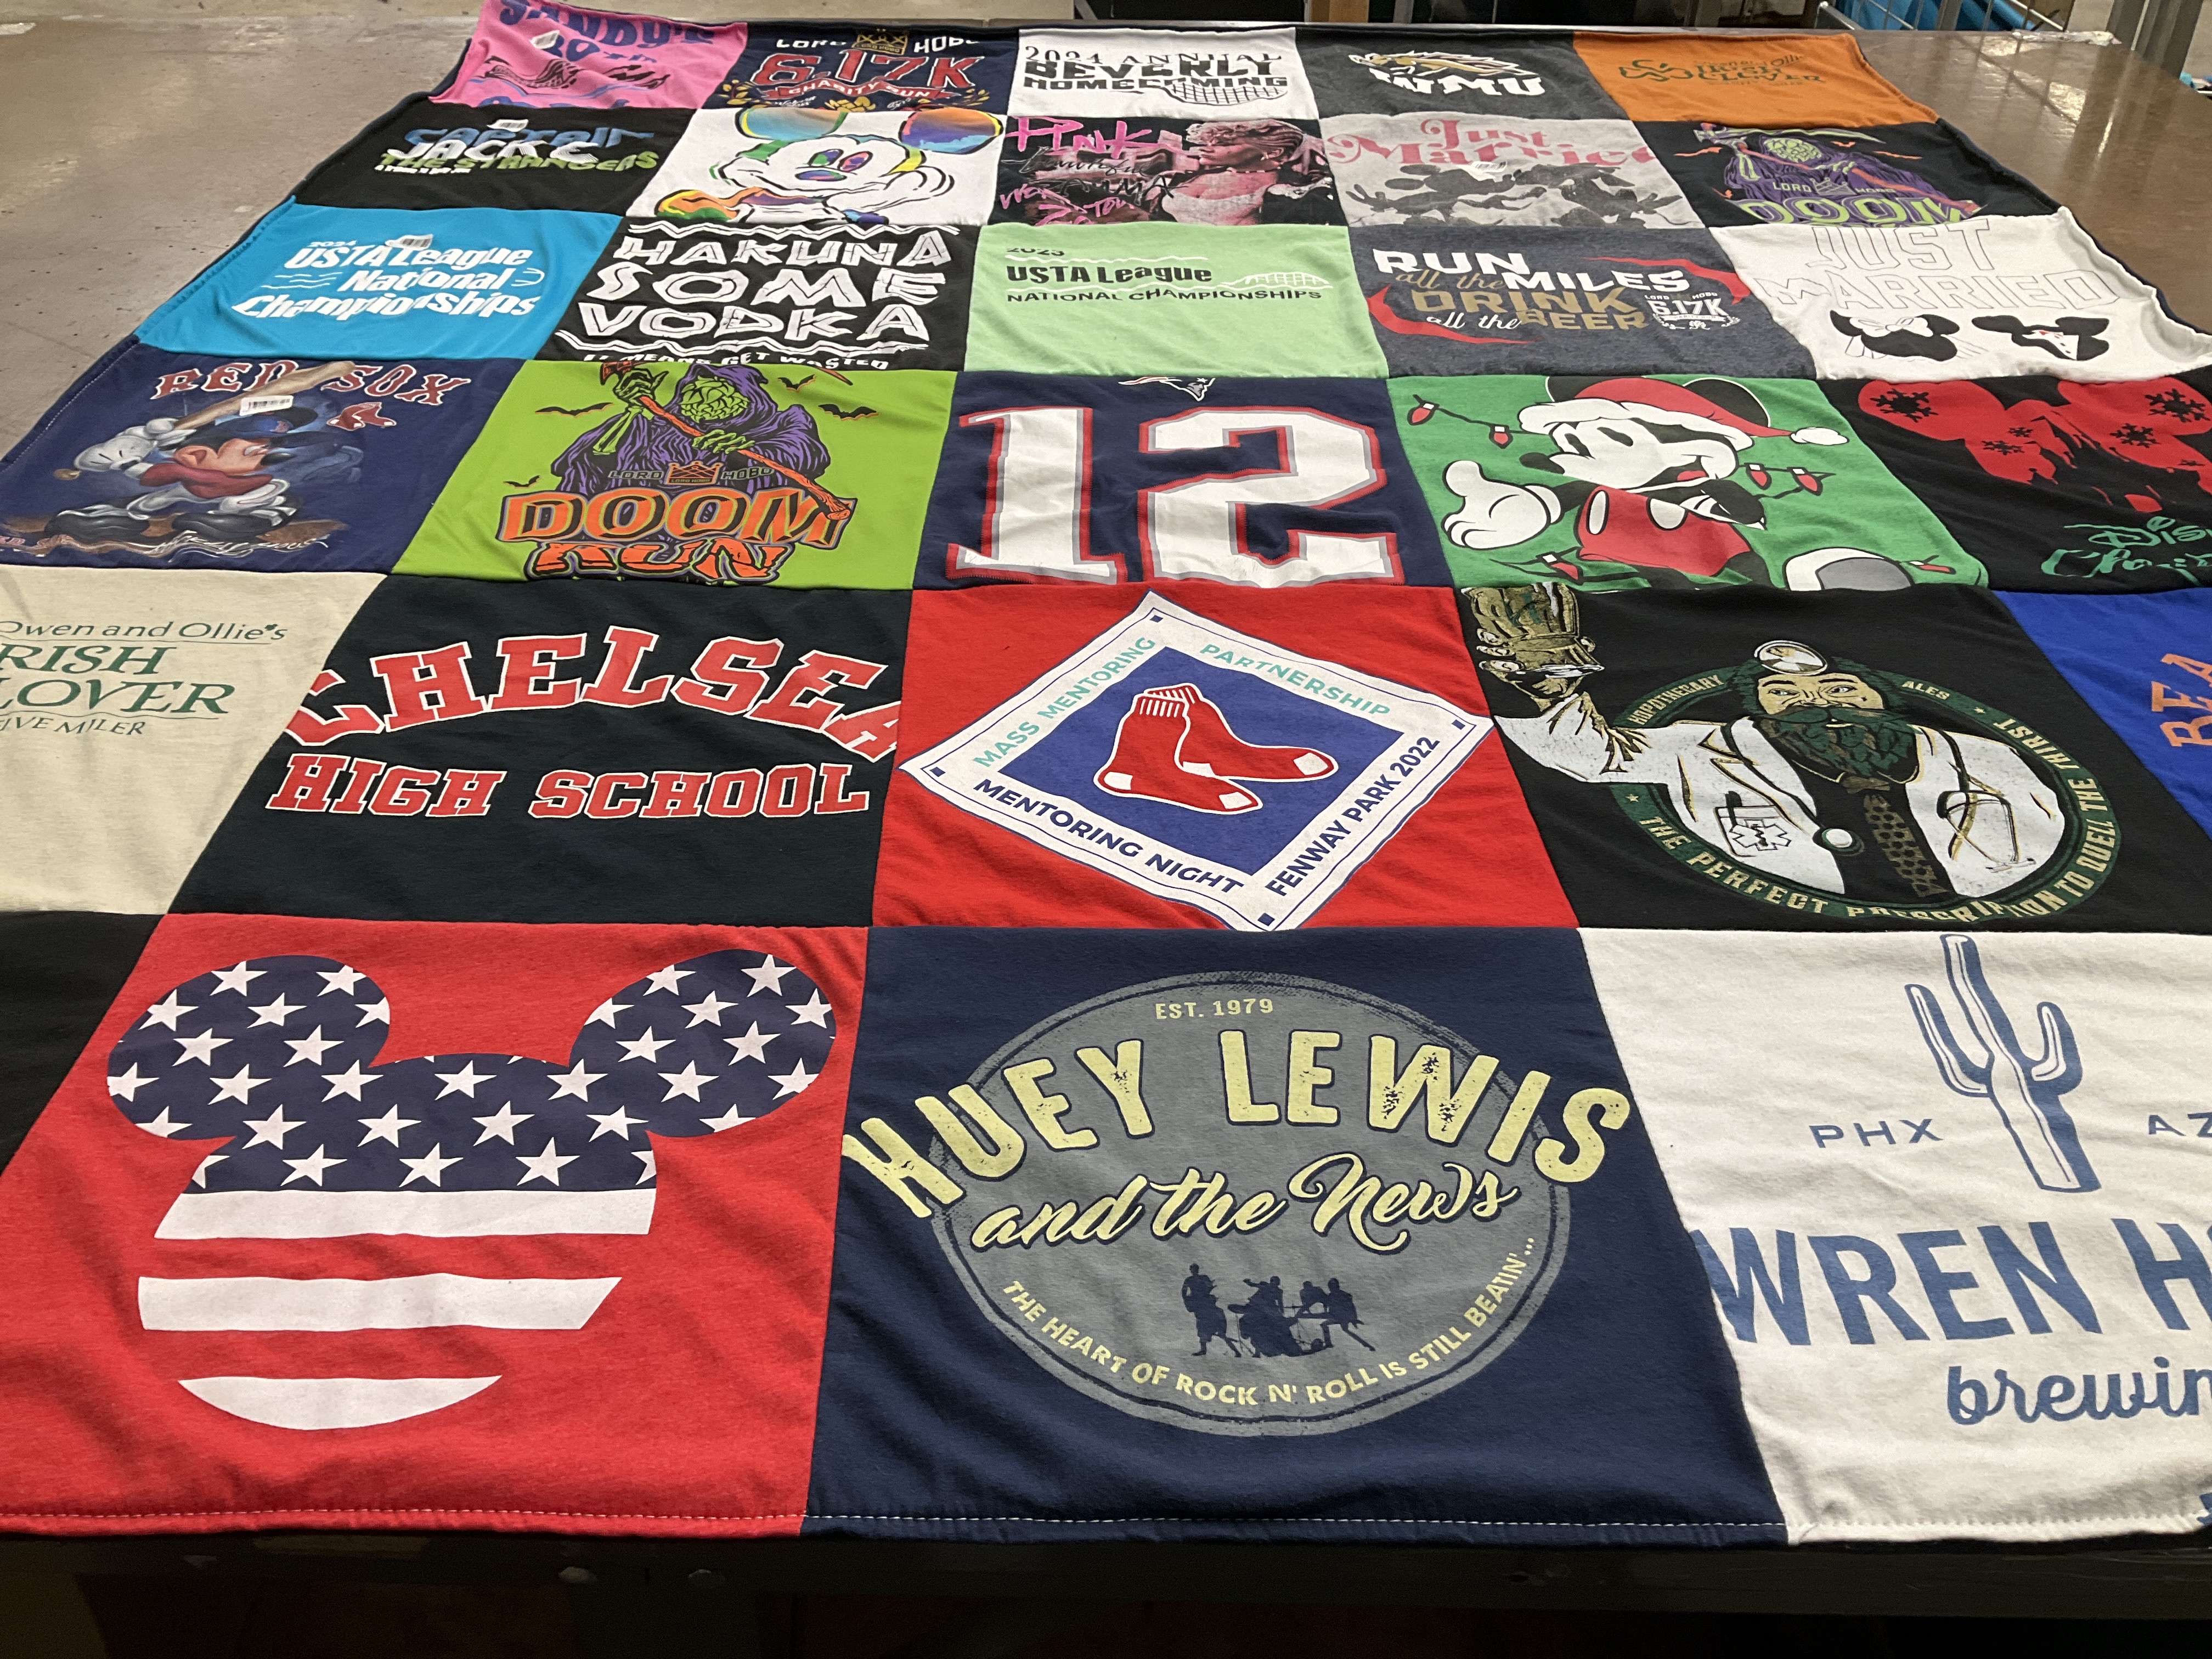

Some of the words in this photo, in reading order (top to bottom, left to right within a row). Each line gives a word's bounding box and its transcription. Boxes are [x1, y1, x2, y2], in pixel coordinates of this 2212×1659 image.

[750, 48, 985, 88] 6.17K
[1023, 76, 1288, 89] HOMECOMING
[1024, 60, 1273, 79] BEVERLY
[788, 80, 879, 95] CHARITY
[885, 86, 930, 97] RUN
[387, 139, 549, 160] JACK
[1420, 119, 1551, 150] Just
[1772, 182, 1812, 193] LORD
[1726, 195, 1980, 225] DOOM
[284, 245, 392, 269] USTA
[388, 246, 534, 271] League
[613, 230, 952, 267] HAKUNA
[1006, 247, 1066, 256] 2023
[1372, 248, 1531, 275] RUN
[1805, 218, 1995, 272] JUST
[337, 267, 517, 291] National
[586, 262, 947, 307] SOME
[1007, 265, 1091, 283] USTA
[1097, 266, 1212, 285] League
[1395, 269, 1441, 290] all
[1452, 272, 1506, 290] the
[1501, 269, 1691, 293] MILES
[1753, 269, 2120, 310] MARRIED
[1007, 291, 1124, 302] NATIONAL
[1128, 288, 1323, 301] CHAMPIONSHIPS
[1410, 286, 1638, 313] DRINK
[1646, 298, 1729, 316] 6.17K
[578, 302, 930, 341] VODKA
[1426, 311, 1465, 329] all
[1478, 312, 1523, 331] the
[1514, 309, 1649, 331] BEER
[720, 352, 771, 365] GET
[149, 359, 300, 400] RED
[319, 363, 472, 405] SOX
[607, 470, 664, 481] LORD
[720, 466, 775, 480] HOBO
[945, 405, 1406, 589] 12
[495, 486, 859, 550] DOOM
[2064, 516, 2212, 548] Dis
[524, 538, 797, 583] RUN
[0, 620, 95, 636] Owen
[101, 620, 174, 637] and
[178, 622, 288, 640] Ollie's
[286, 624, 902, 763] CHELSEA
[1200, 643, 1391, 718] PARTNERSHIP
[972, 721, 1040, 768] MASS
[1037, 636, 1156, 719] MENTORING
[1627, 674, 1724, 725] HOPOTHECARY
[1901, 680, 1950, 700] ALES
[0, 716, 54, 732] IVE
[53, 719, 146, 735] MILER
[1993, 718, 2080, 770] THIRST
[266, 752, 507, 819] HIGH
[528, 763, 871, 820] SCHOOL
[2068, 777, 2108, 811] THE
[1264, 819, 1352, 896] FENWAY
[1341, 774, 1402, 822] PARK
[1390, 737, 1441, 777] 2022
[1639, 815, 1692, 851] THE
[973, 778, 1144, 857] MENTORING
[1144, 853, 1245, 893] NIGHT
[2076, 819, 2115, 872] QUELL
[1686, 851, 1829, 914] PERFECT
[2054, 871, 2095, 898] TO
[1847, 890, 2068, 923] PRESCRIPTION
[1155, 1000, 1206, 1021] EST.
[1212, 997, 1275, 1017] 1979
[842, 1037, 1147, 1219] HUEY
[1218, 1028, 1632, 1184] LEWIS
[1808, 1118, 1944, 1148] PHX
[970, 1175, 1149, 1252] and
[1147, 1166, 1288, 1238] the
[1289, 1152, 1520, 1254] News
[1690, 1220, 2103, 1347] WREN
[2111, 1217, 2212, 1331] H
[1003, 1280, 1047, 1322] THE
[1041, 1317, 1127, 1374] HEART
[1132, 1362, 1170, 1385] OF
[1176, 1373, 1259, 1406] ROCK
[1268, 1383, 1297, 1403] N'
[1306, 1368, 1379, 1404] ROLL
[1379, 1361, 1407, 1380] IS
[1408, 1326, 1472, 1370] STILL
